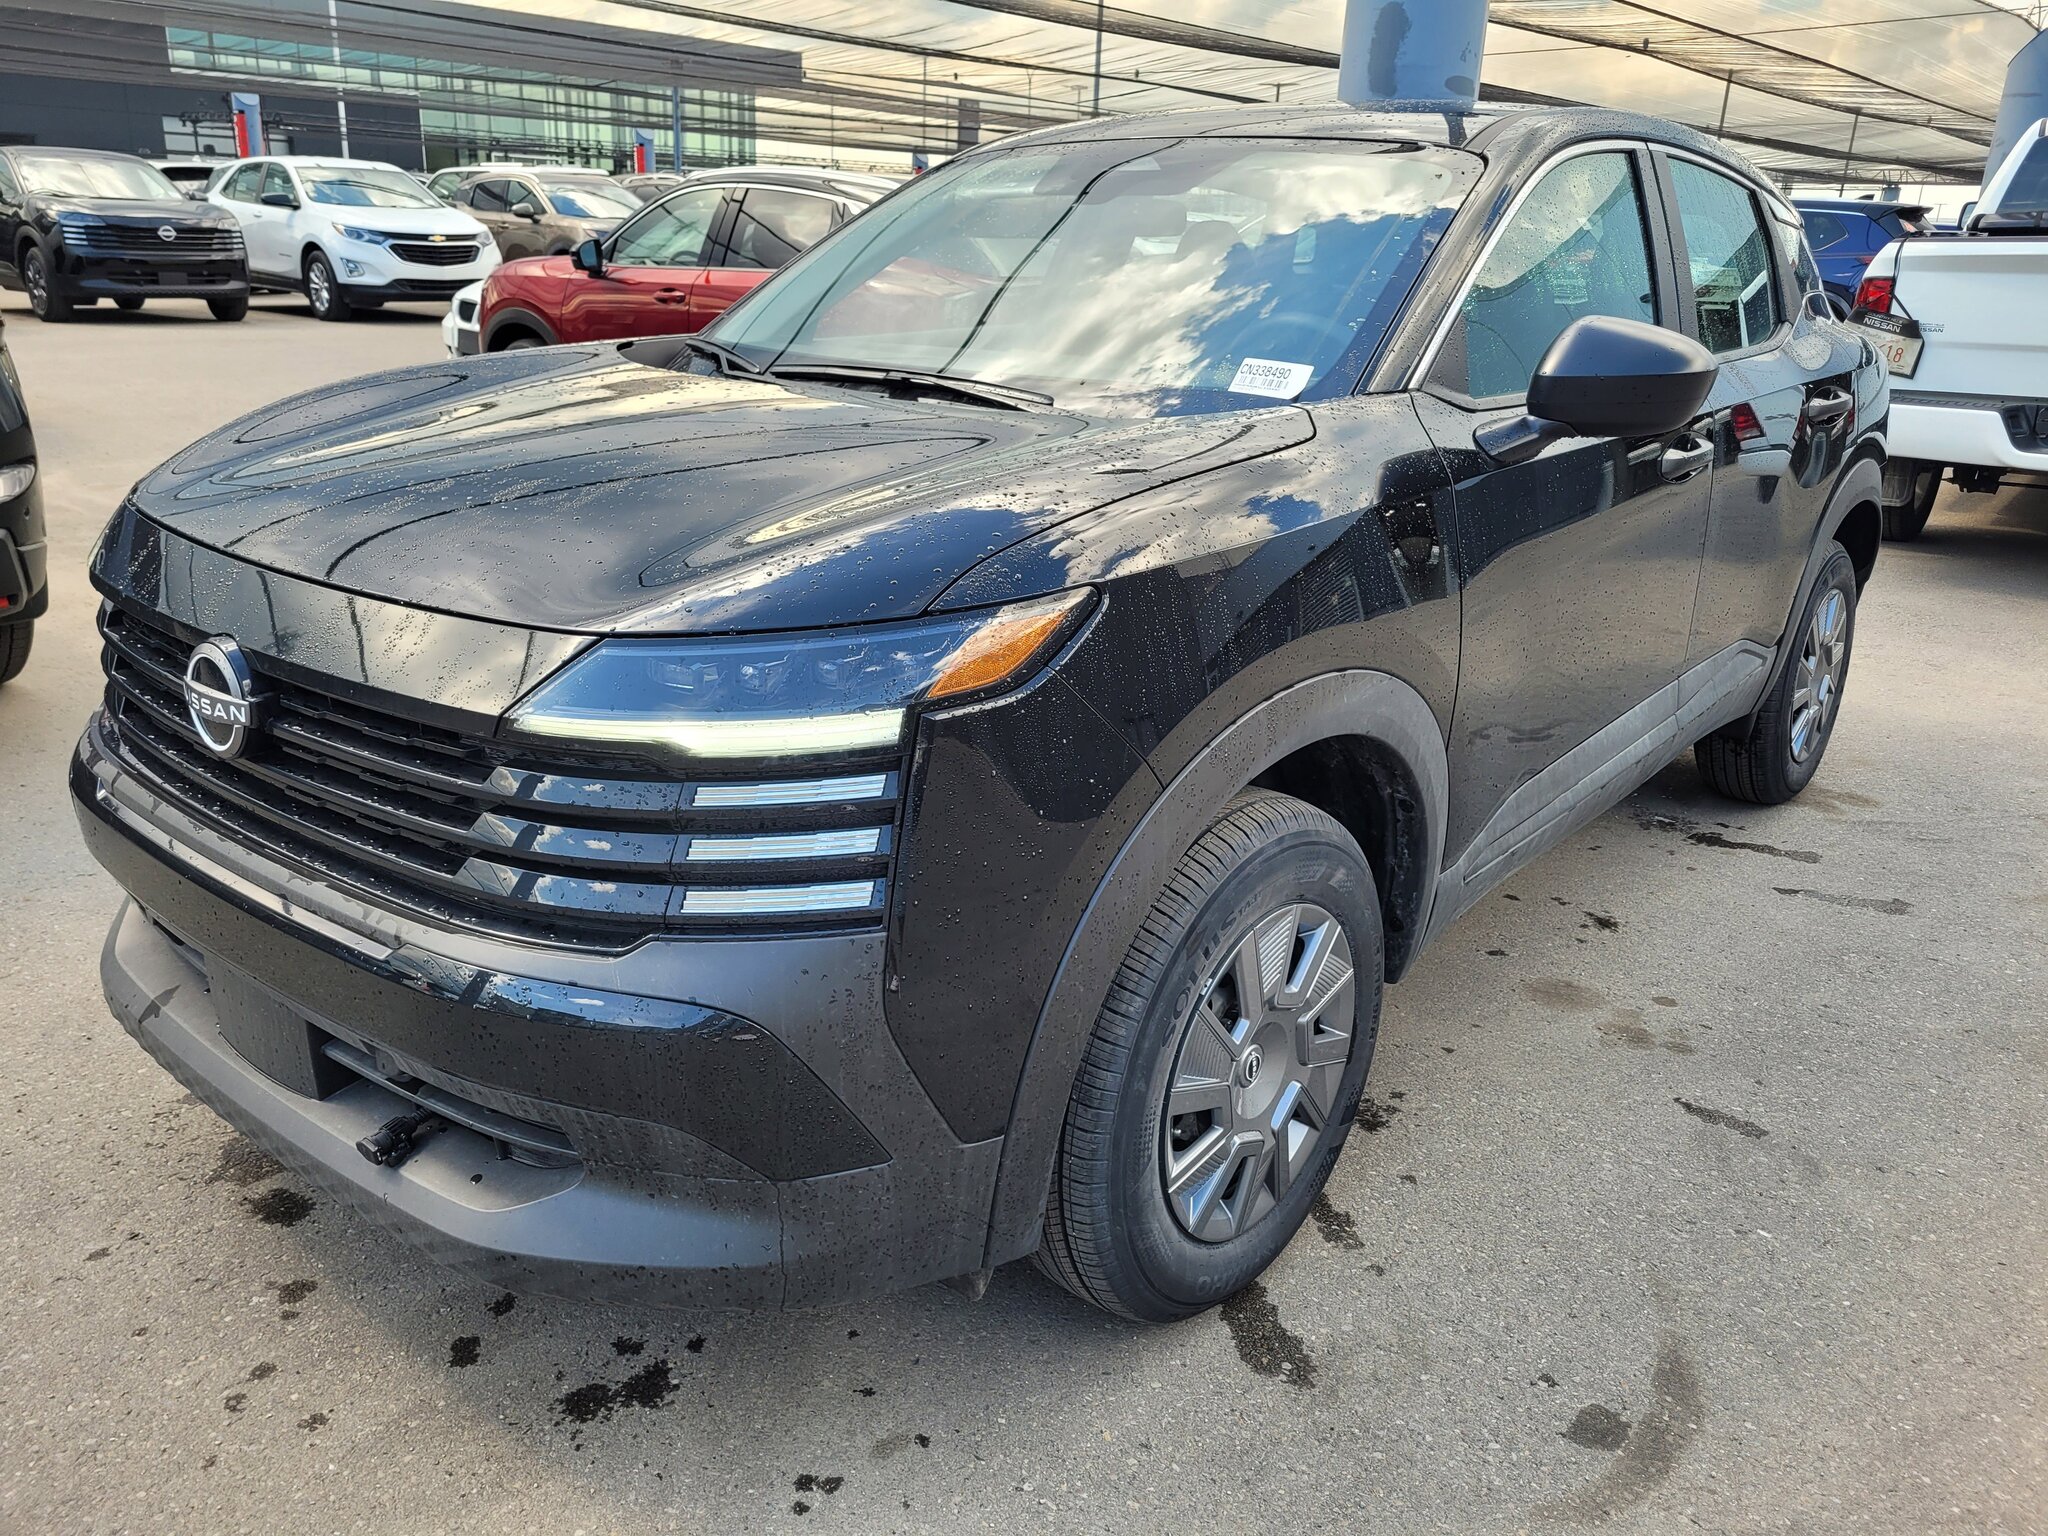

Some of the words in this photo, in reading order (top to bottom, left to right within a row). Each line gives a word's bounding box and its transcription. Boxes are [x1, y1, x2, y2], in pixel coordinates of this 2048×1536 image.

[1863, 317, 1901, 333] NISSAN
[1880, 344, 1904, 363] 18
[1240, 363, 1292, 379] CN338490
[188, 689, 246, 723] ISSAN
